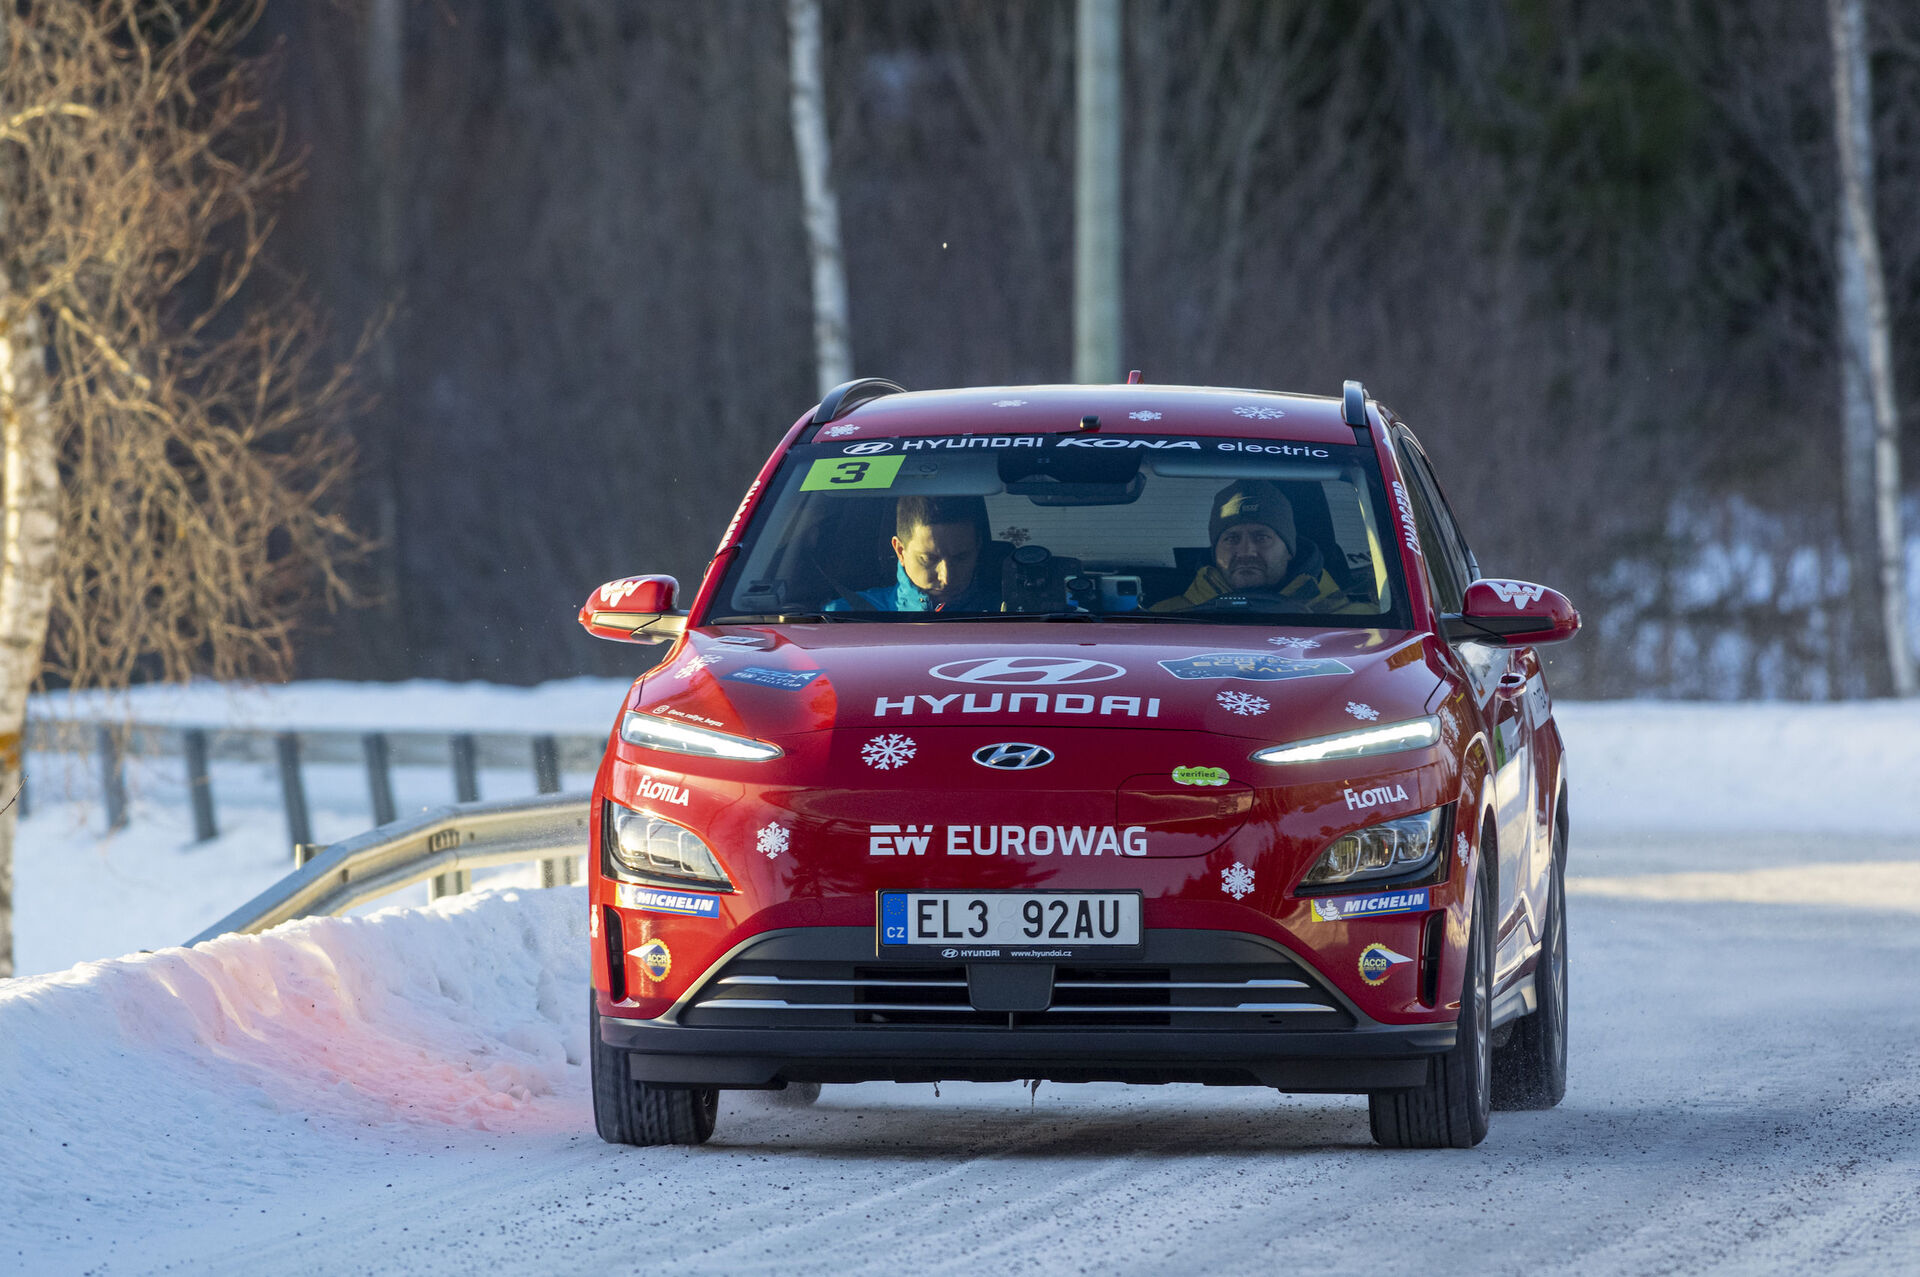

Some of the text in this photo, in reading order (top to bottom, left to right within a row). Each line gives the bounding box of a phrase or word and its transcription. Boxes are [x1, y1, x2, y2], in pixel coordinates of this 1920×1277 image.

[902, 437, 1329, 458] HYUNDAI KONA electric
[829, 461, 871, 484] 3
[873, 692, 1161, 718] HYUNDAI
[1180, 770, 1216, 778] verified
[636, 775, 690, 807] FLOTILA
[1343, 784, 1409, 811] FLOTILA
[946, 825, 1148, 856] EUROWAG
[637, 891, 715, 912] MICHELIN
[1343, 893, 1425, 913] MICHELIN
[917, 899, 1120, 939] EL3 92AU
[886, 926, 905, 938] CZ
[647, 954, 667, 964] ACCR
[960, 949, 1073, 958] HYUNDAI www.hyundai.cz
[1363, 958, 1387, 967] ACCR
